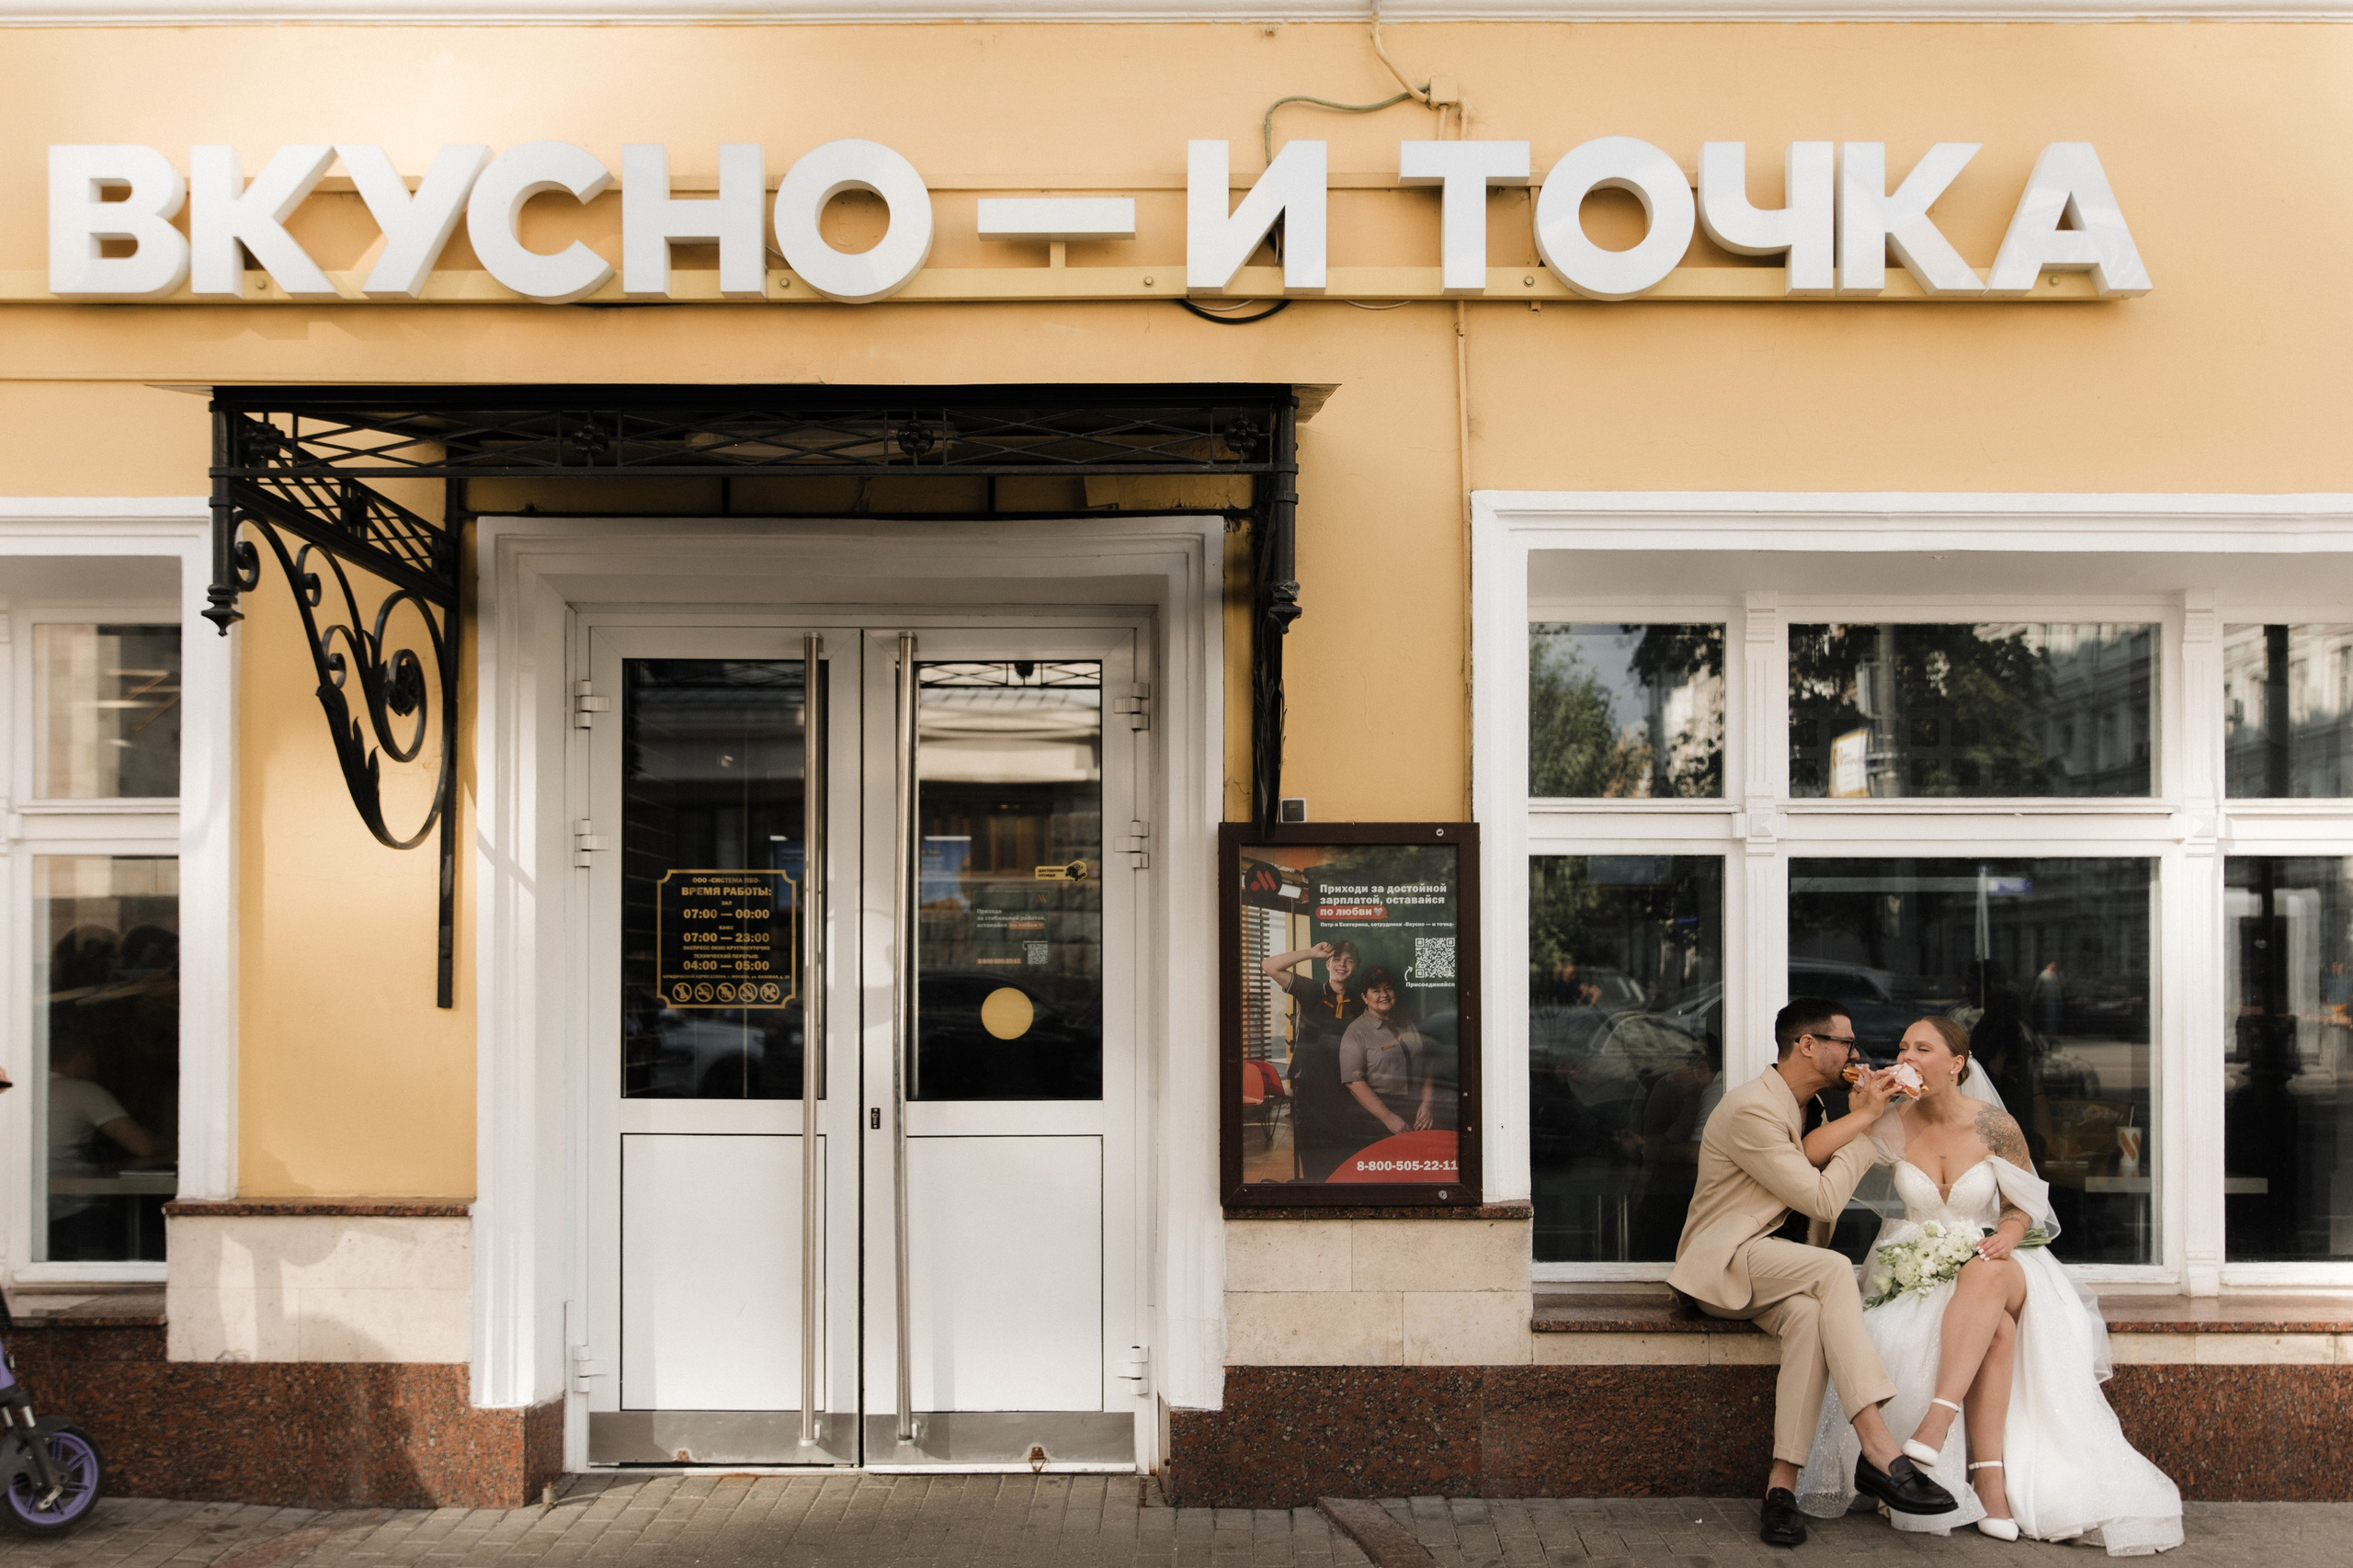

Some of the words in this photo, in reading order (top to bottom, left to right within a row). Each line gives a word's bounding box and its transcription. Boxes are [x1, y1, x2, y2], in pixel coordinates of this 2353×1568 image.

[48, 138, 934, 304] ВКУСНО
[1187, 139, 1328, 294] И
[1399, 135, 2154, 301] ТОЧКА
[681, 887, 721, 896] ВРЕМЯ
[723, 887, 772, 896] РАБОТЫ:
[1320, 883, 1369, 894] Приходи
[1370, 885, 1384, 893] за
[1387, 883, 1447, 894] достойной
[1320, 894, 1383, 905] зарплатой,
[1386, 894, 1445, 904] оставайся
[683, 909, 718, 919] 07:00
[735, 909, 770, 919] 00:00
[1336, 906, 1372, 916] любви
[683, 933, 718, 943] 07:00
[735, 933, 770, 943] 23:00
[683, 960, 718, 971] 04:00
[735, 960, 770, 971] 05:00
[1357, 1160, 1459, 1171] 8-800-505-22-11
